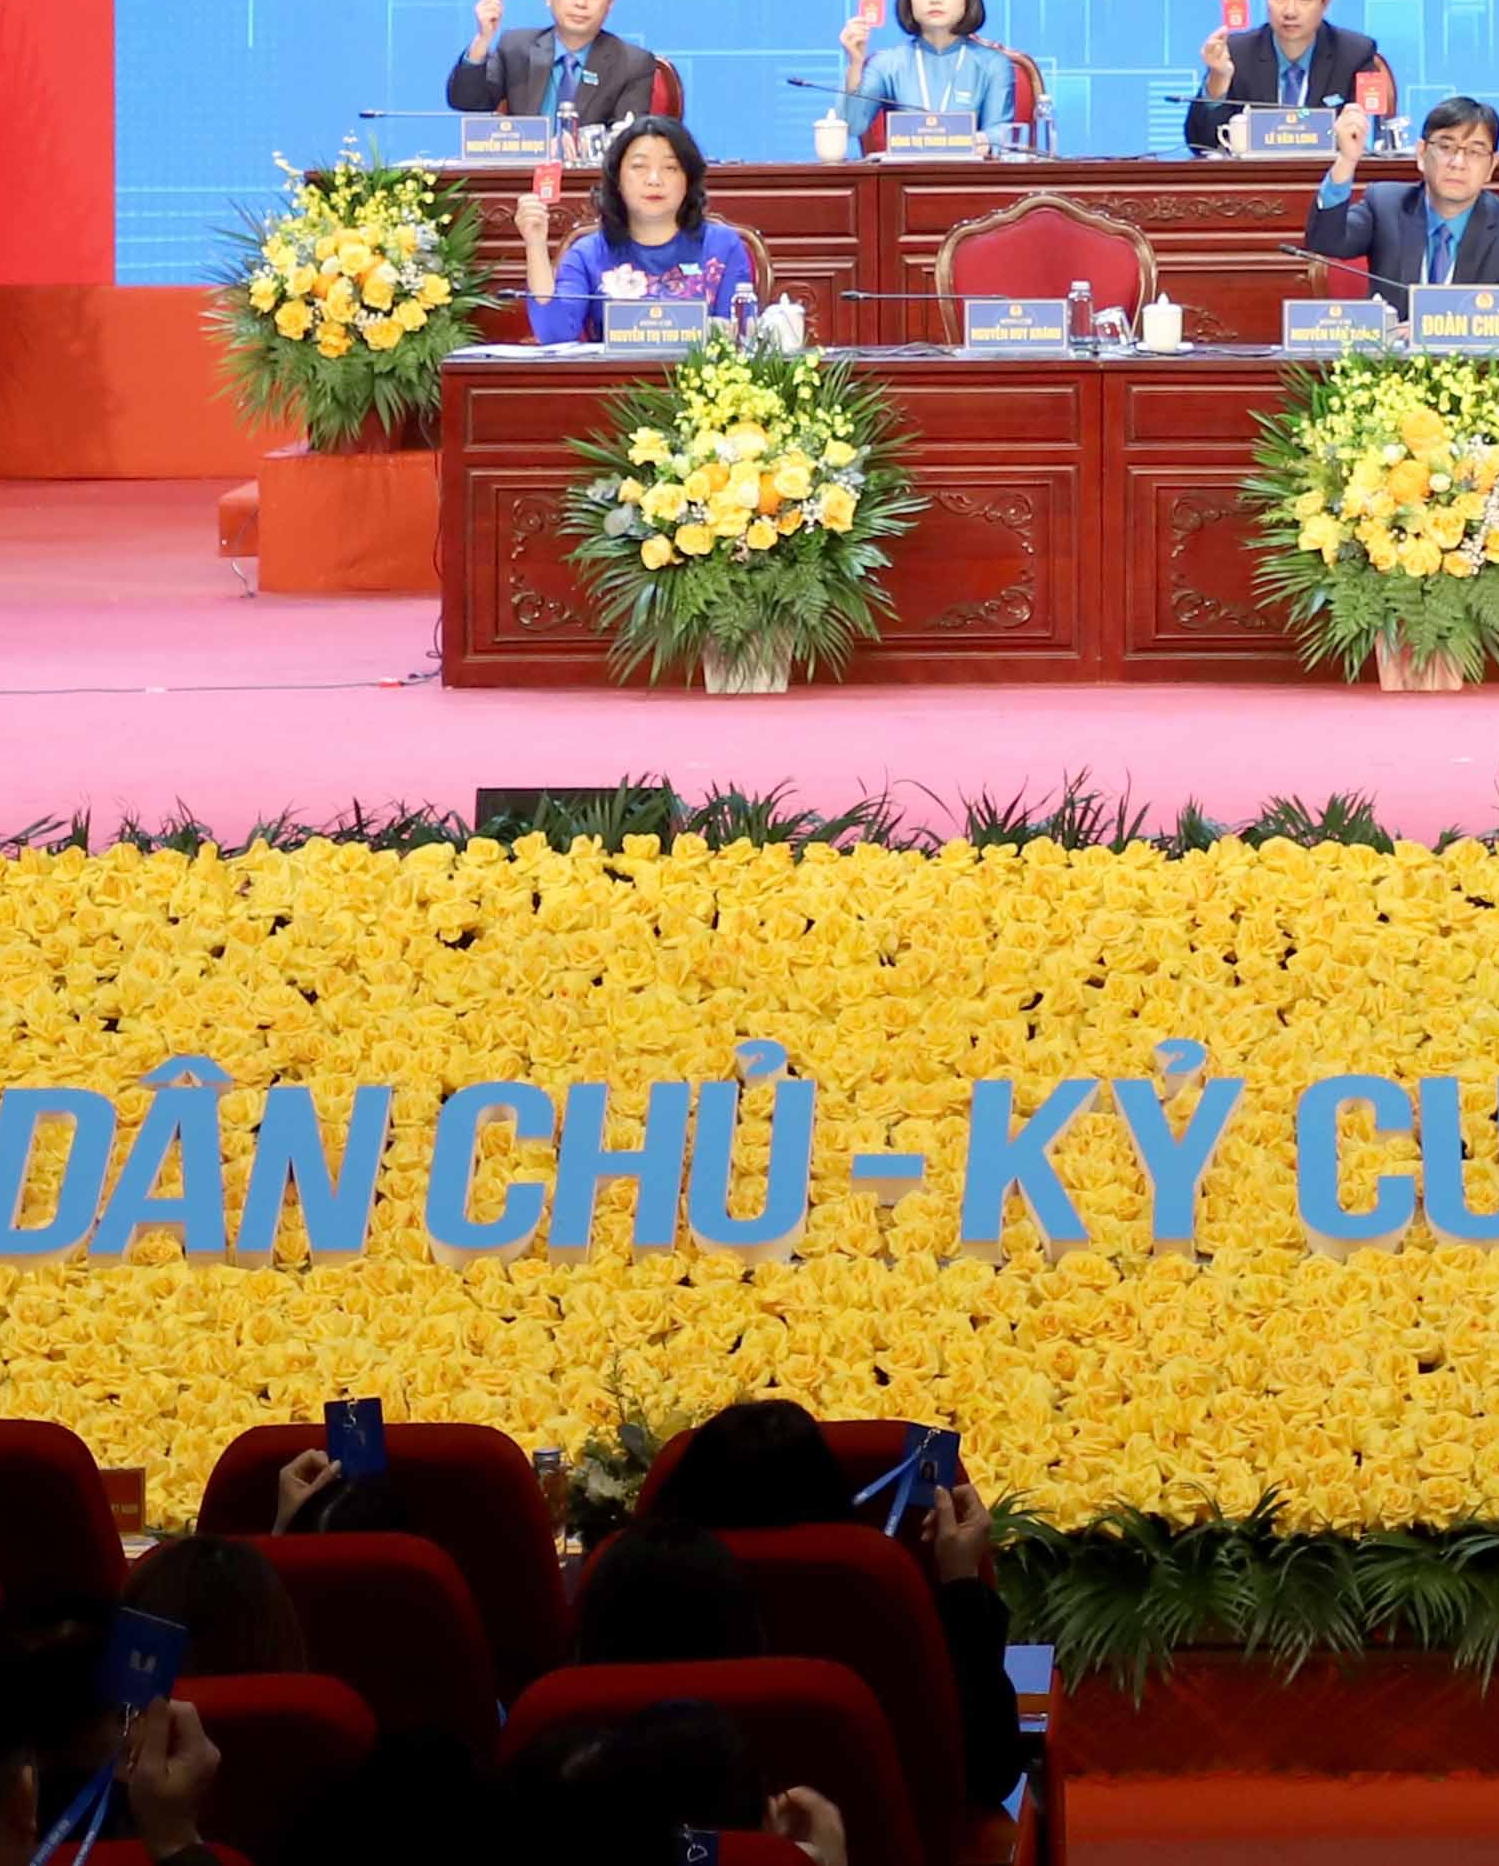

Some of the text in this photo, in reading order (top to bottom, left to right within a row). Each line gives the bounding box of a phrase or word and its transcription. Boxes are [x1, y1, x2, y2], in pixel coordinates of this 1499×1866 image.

[1421, 310, 1469, 337] ĐOÀN
[424, 1036, 817, 1254] CHỦ
[957, 1036, 1248, 1246] KỶ
